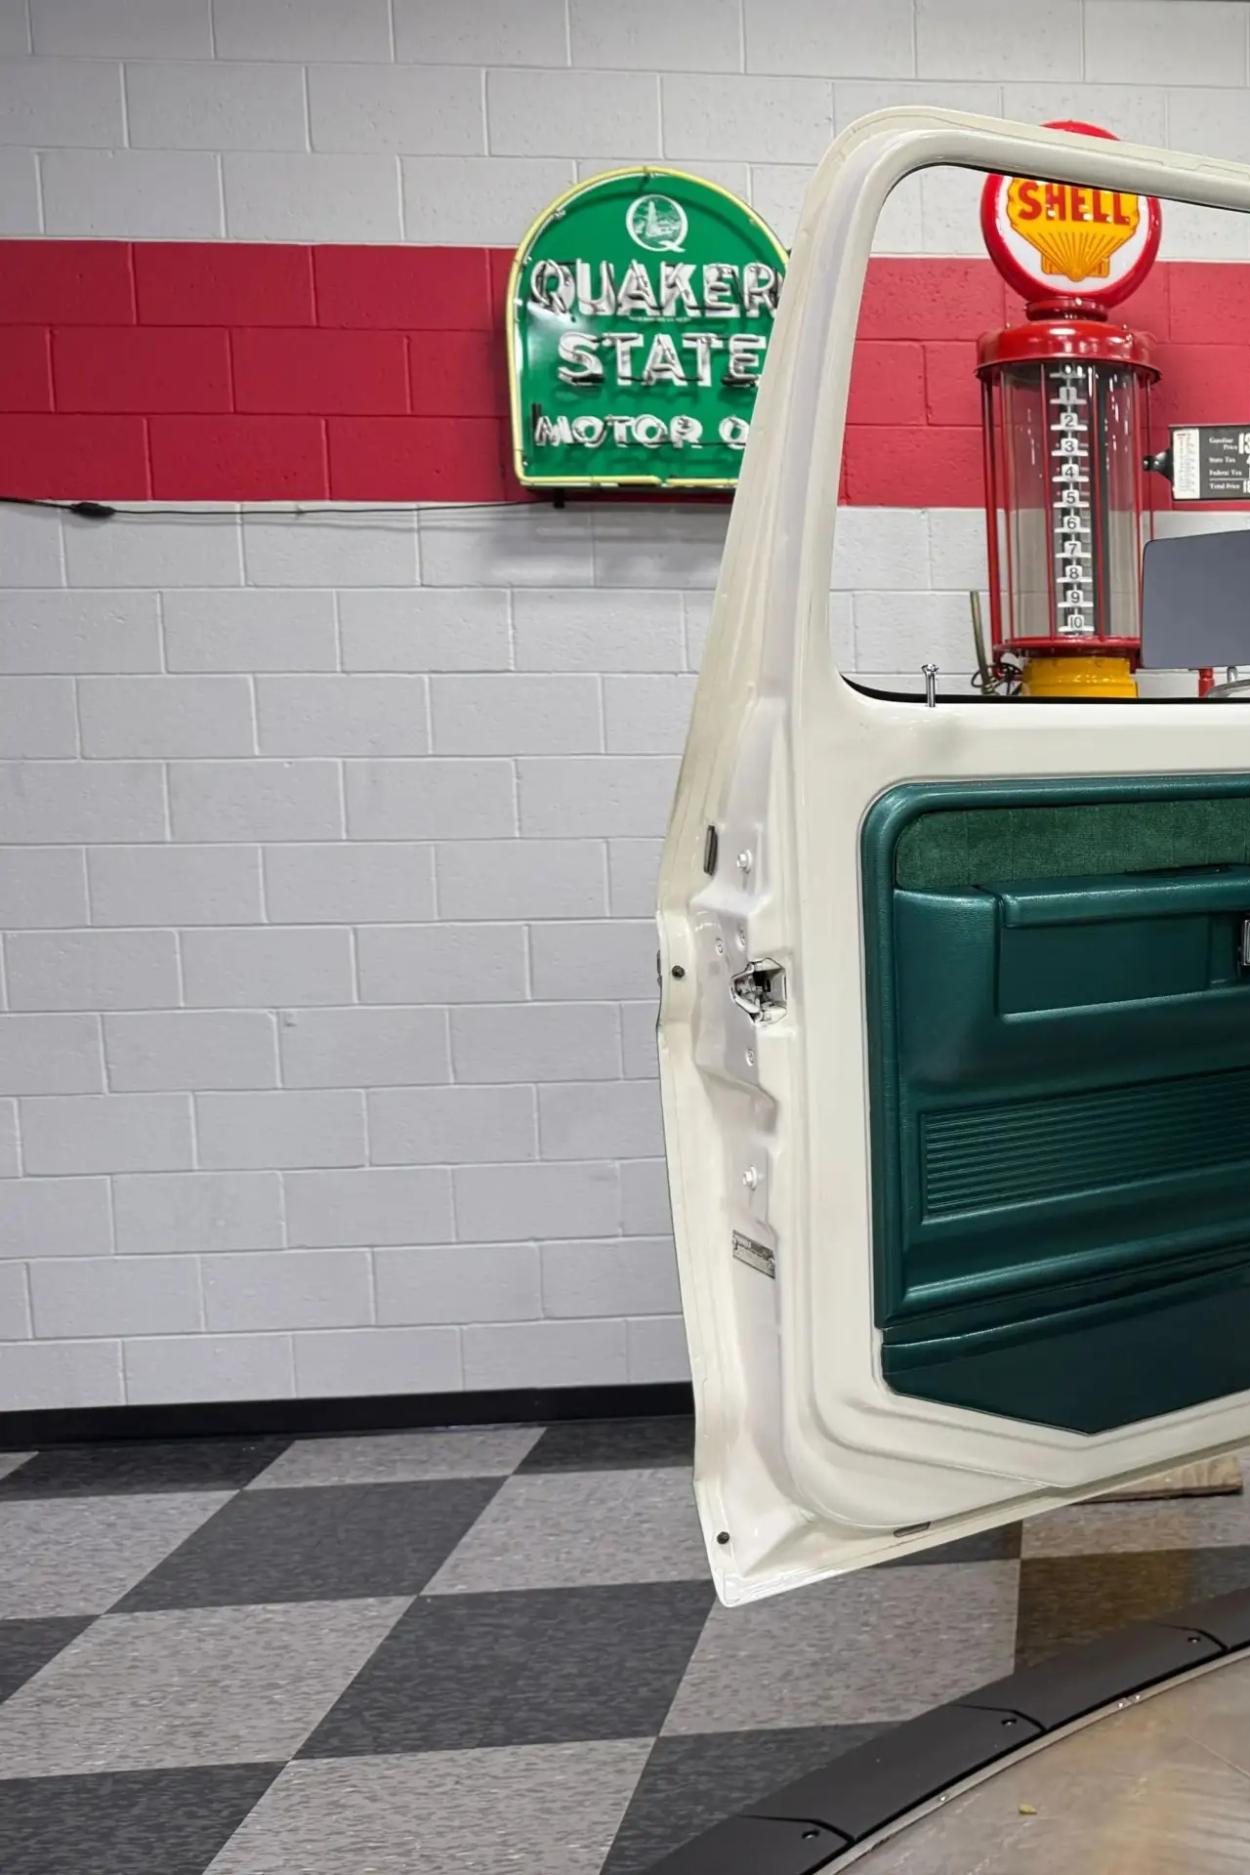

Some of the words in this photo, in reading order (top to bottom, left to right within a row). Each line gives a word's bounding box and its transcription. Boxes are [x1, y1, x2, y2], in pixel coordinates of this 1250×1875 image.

[1018, 181, 1130, 226] SHELL
[530, 259, 784, 317] QUAKER
[557, 331, 767, 387] STATE
[535, 414, 703, 448] MOTOR
